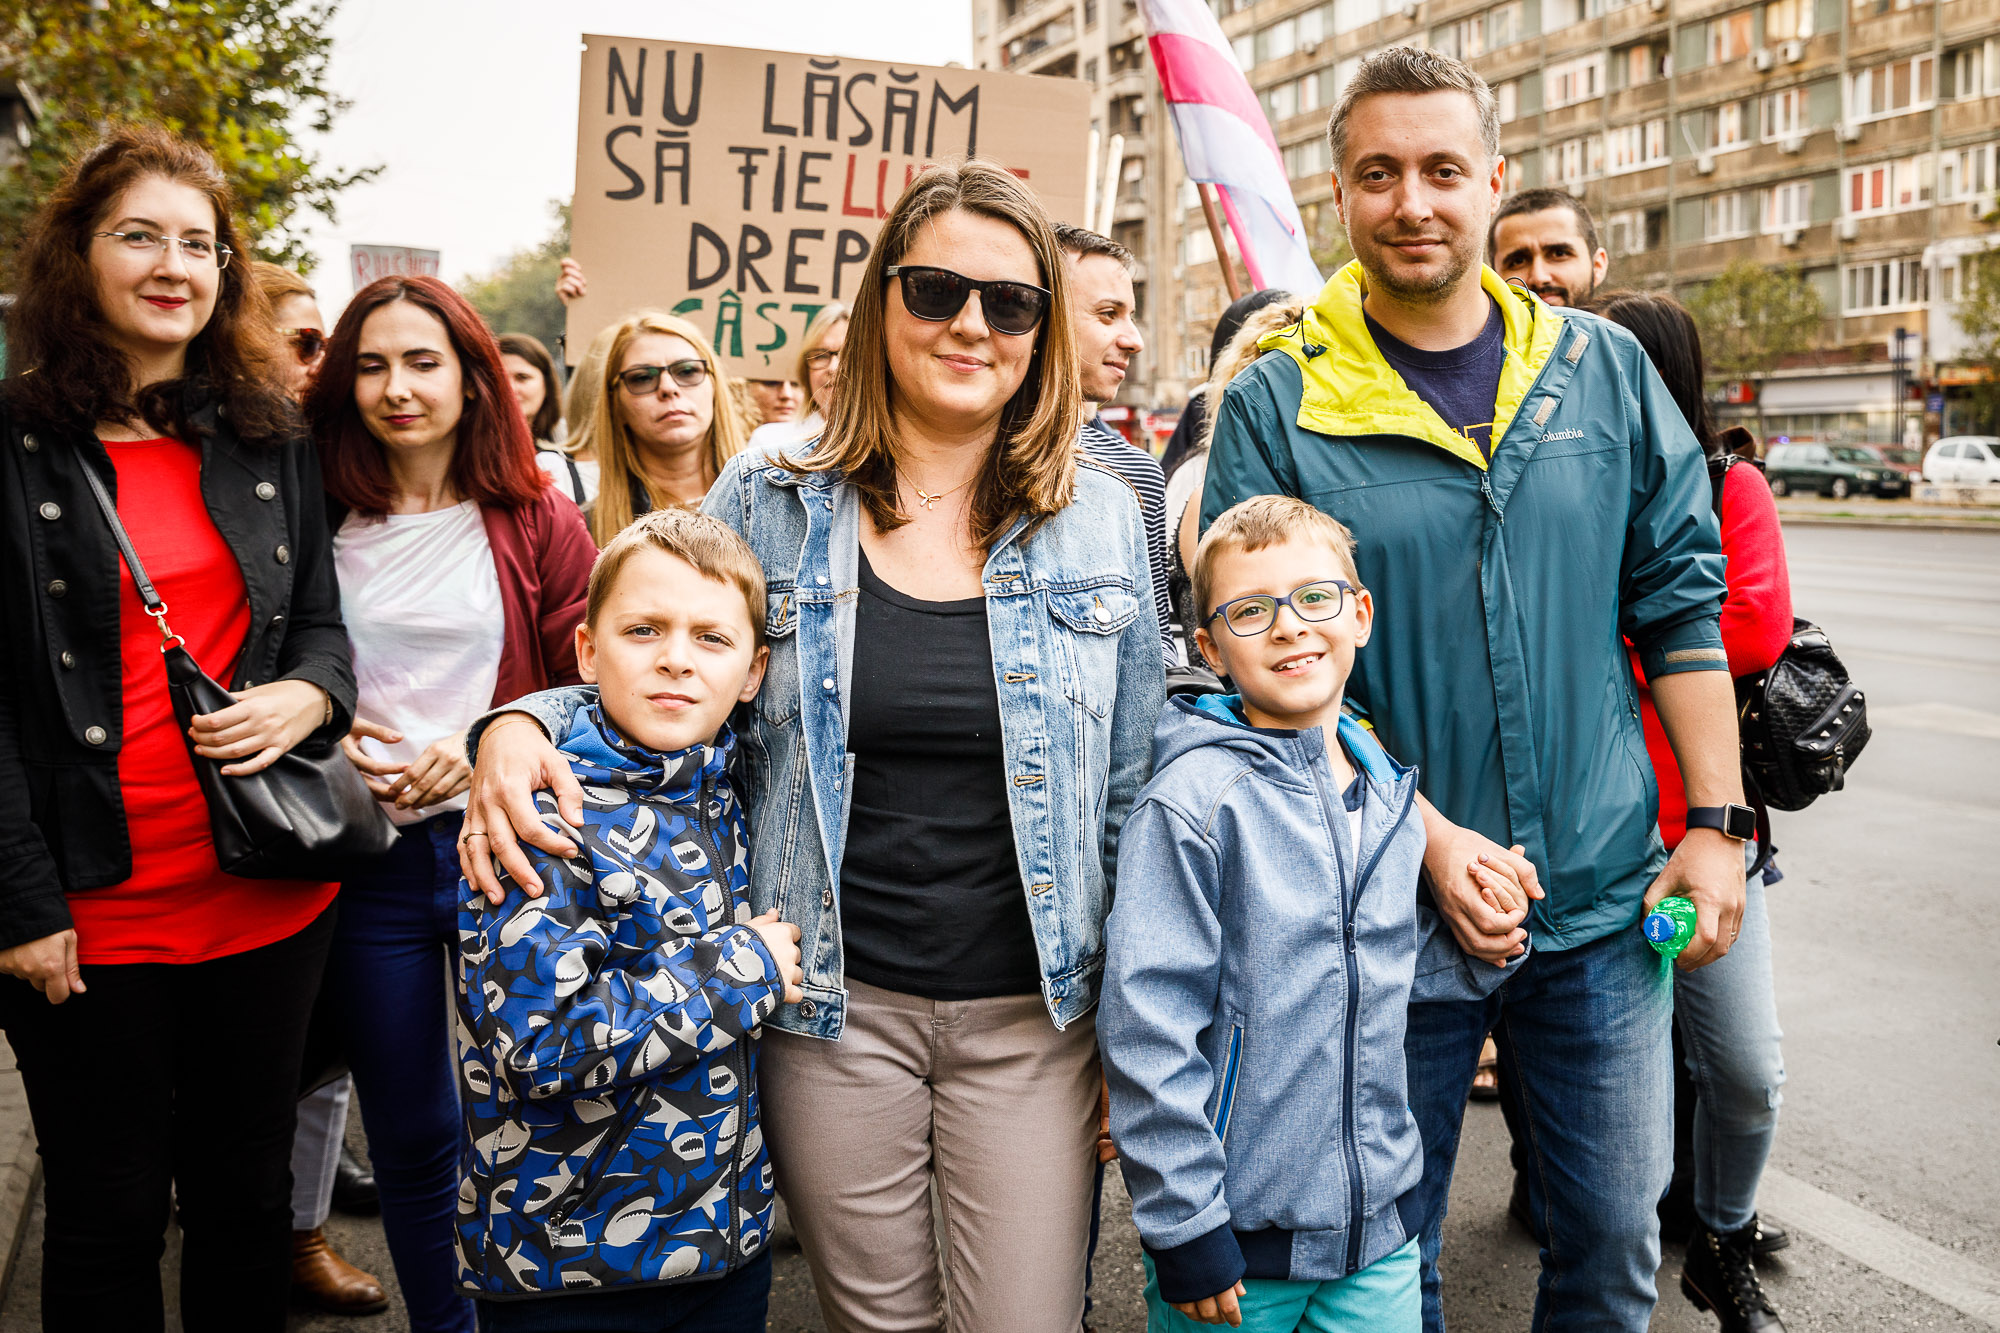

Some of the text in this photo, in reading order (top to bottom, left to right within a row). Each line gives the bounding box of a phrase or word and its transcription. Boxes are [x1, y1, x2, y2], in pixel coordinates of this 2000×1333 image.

[606, 46, 980, 161] NU LĂSĂM
[605, 124, 690, 206] SĂ
[687, 222, 870, 299] DREP
[1538, 428, 1584, 443] olumbia
[1651, 918, 1661, 940] Sprite
